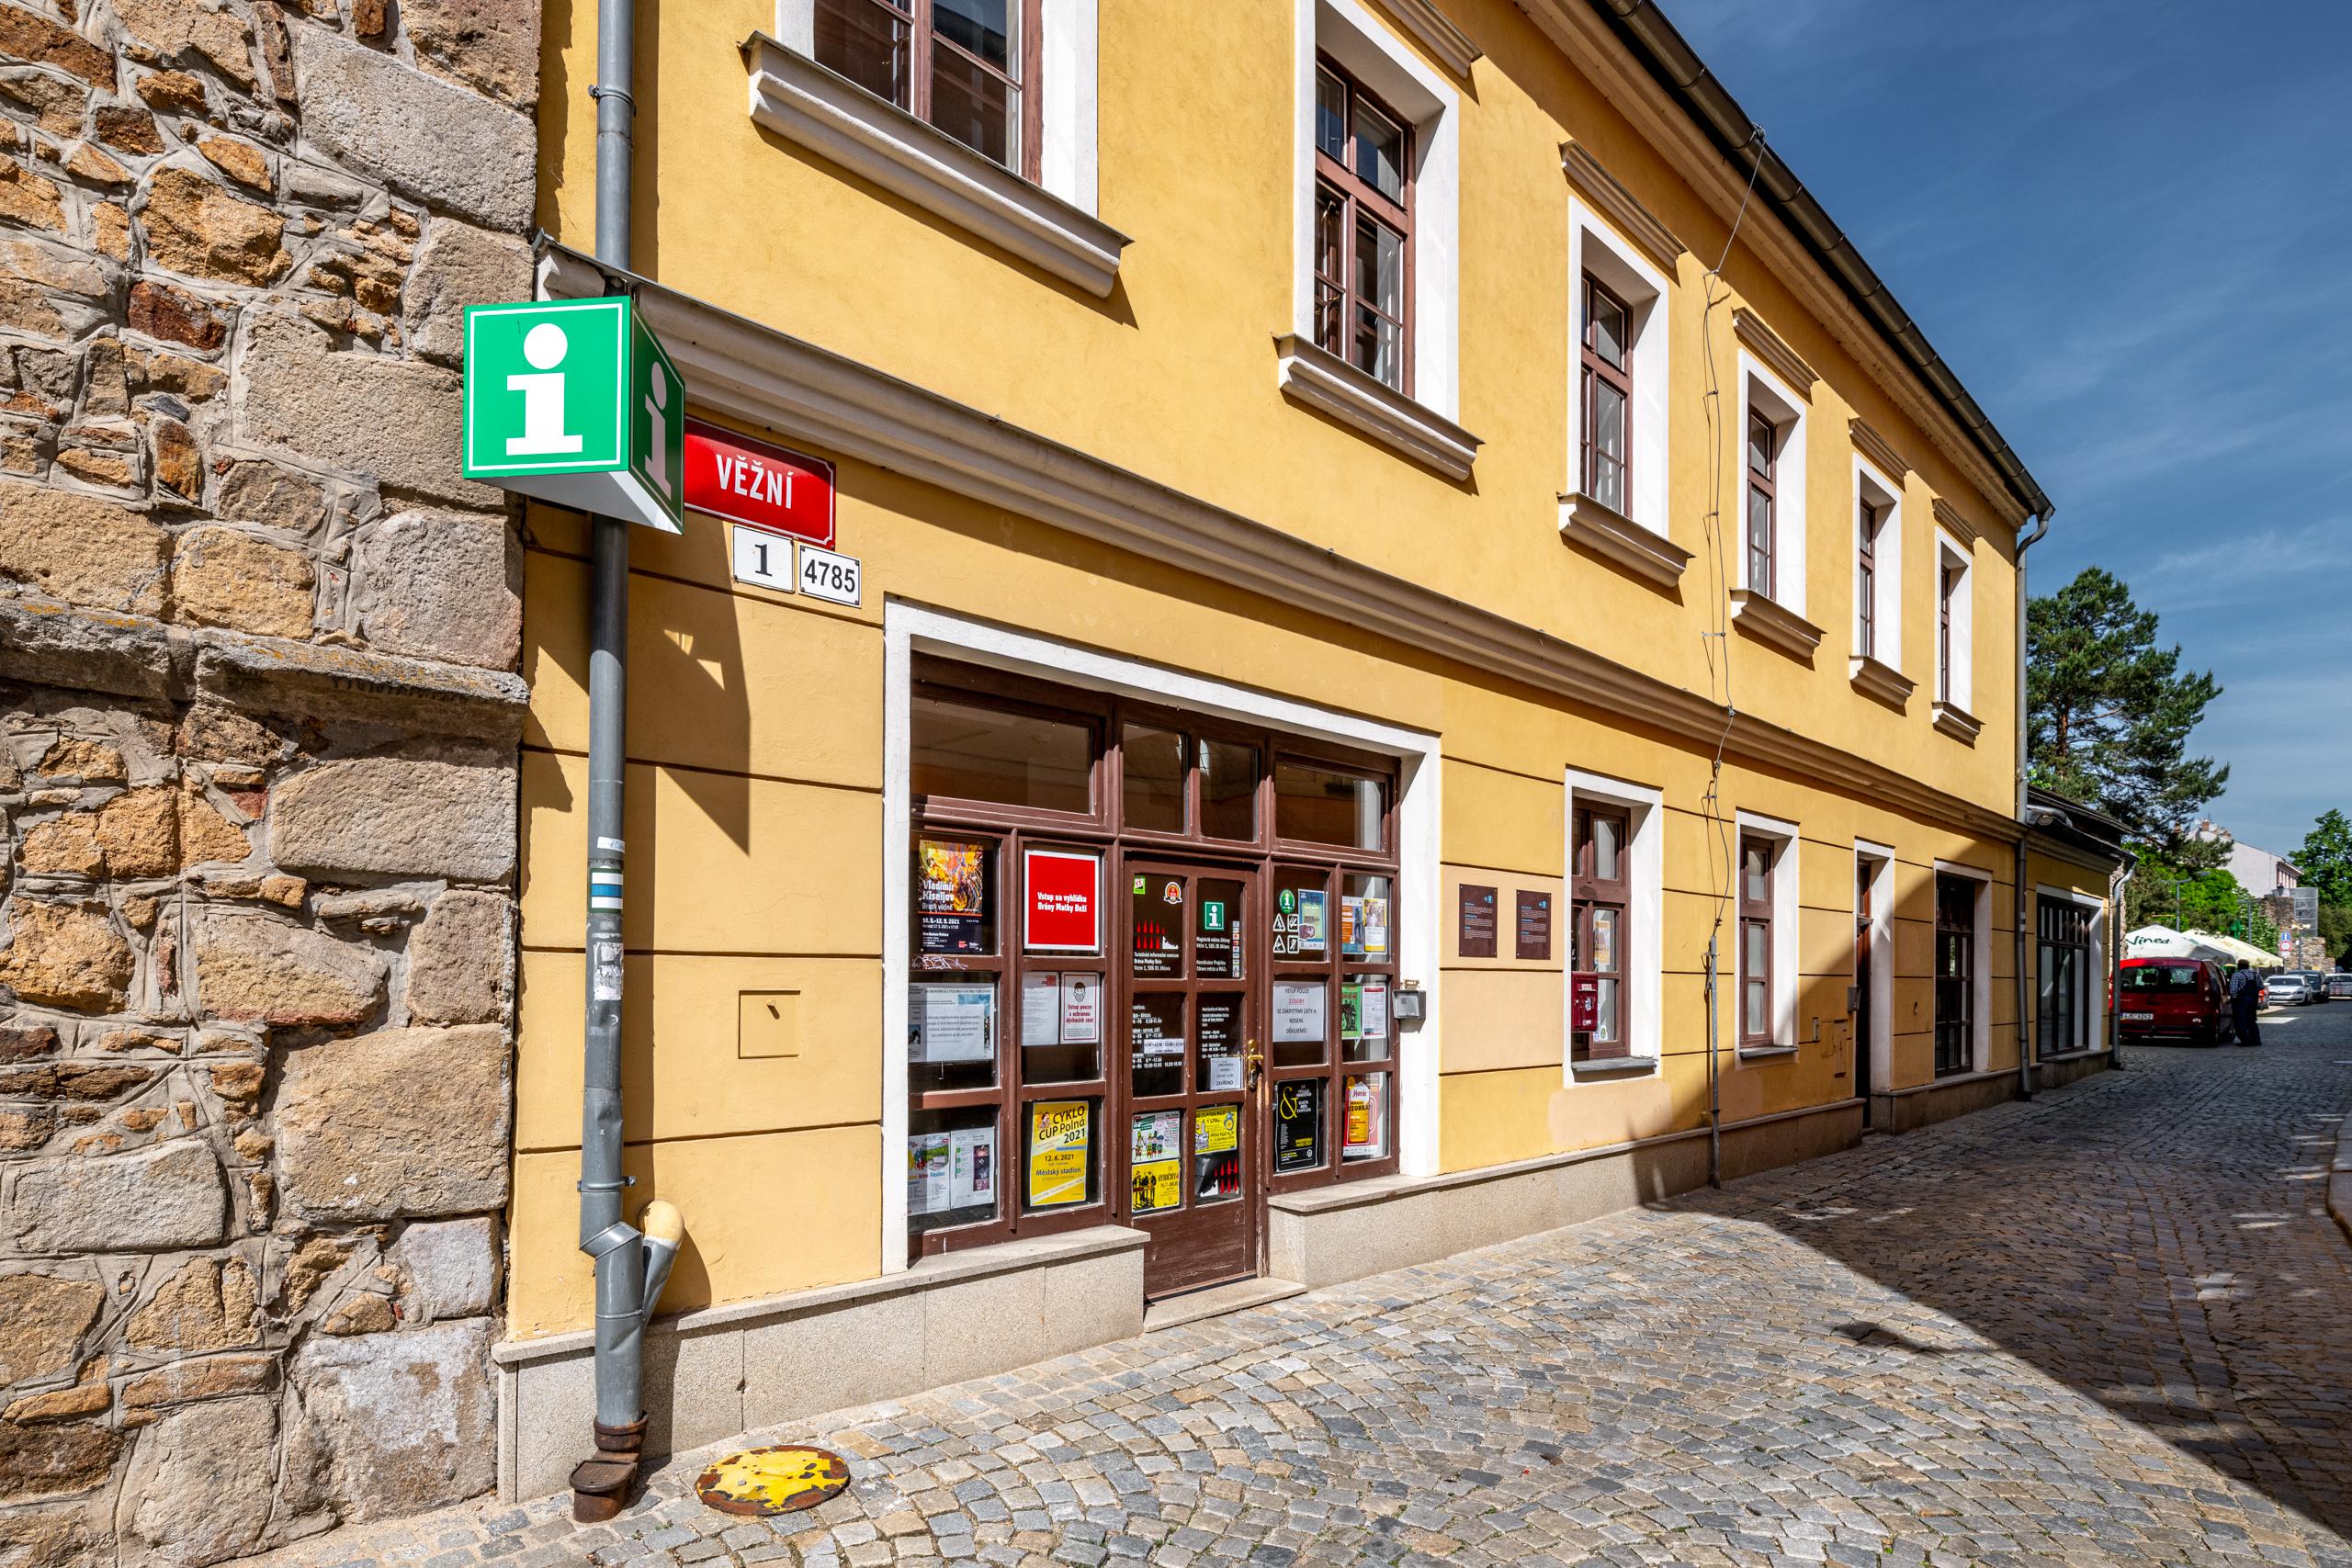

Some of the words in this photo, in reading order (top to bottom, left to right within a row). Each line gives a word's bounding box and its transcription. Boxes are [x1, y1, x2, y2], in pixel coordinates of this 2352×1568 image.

[716, 454, 794, 510] VĚŽNÍ
[754, 544, 773, 577] 1
[804, 558, 856, 593] 4785
[922, 879, 955, 891] Vladimír
[922, 891, 955, 903] Kiseljov
[1037, 892, 1054, 902] Vstup
[1063, 894, 1087, 903] vyhlídku
[1037, 902, 1055, 912] Brány
[1056, 903, 1074, 913] Matky
[1074, 904, 1088, 912] Boží
[2126, 935, 2171, 945] Vinea
[1053, 1105, 1085, 1124] CYKLO
[1039, 1126, 1057, 1140] CUP
[1059, 1116, 1085, 1134] Polná
[1064, 1128, 1085, 1144] 2021
[1035, 1168, 1059, 1176] Městský
